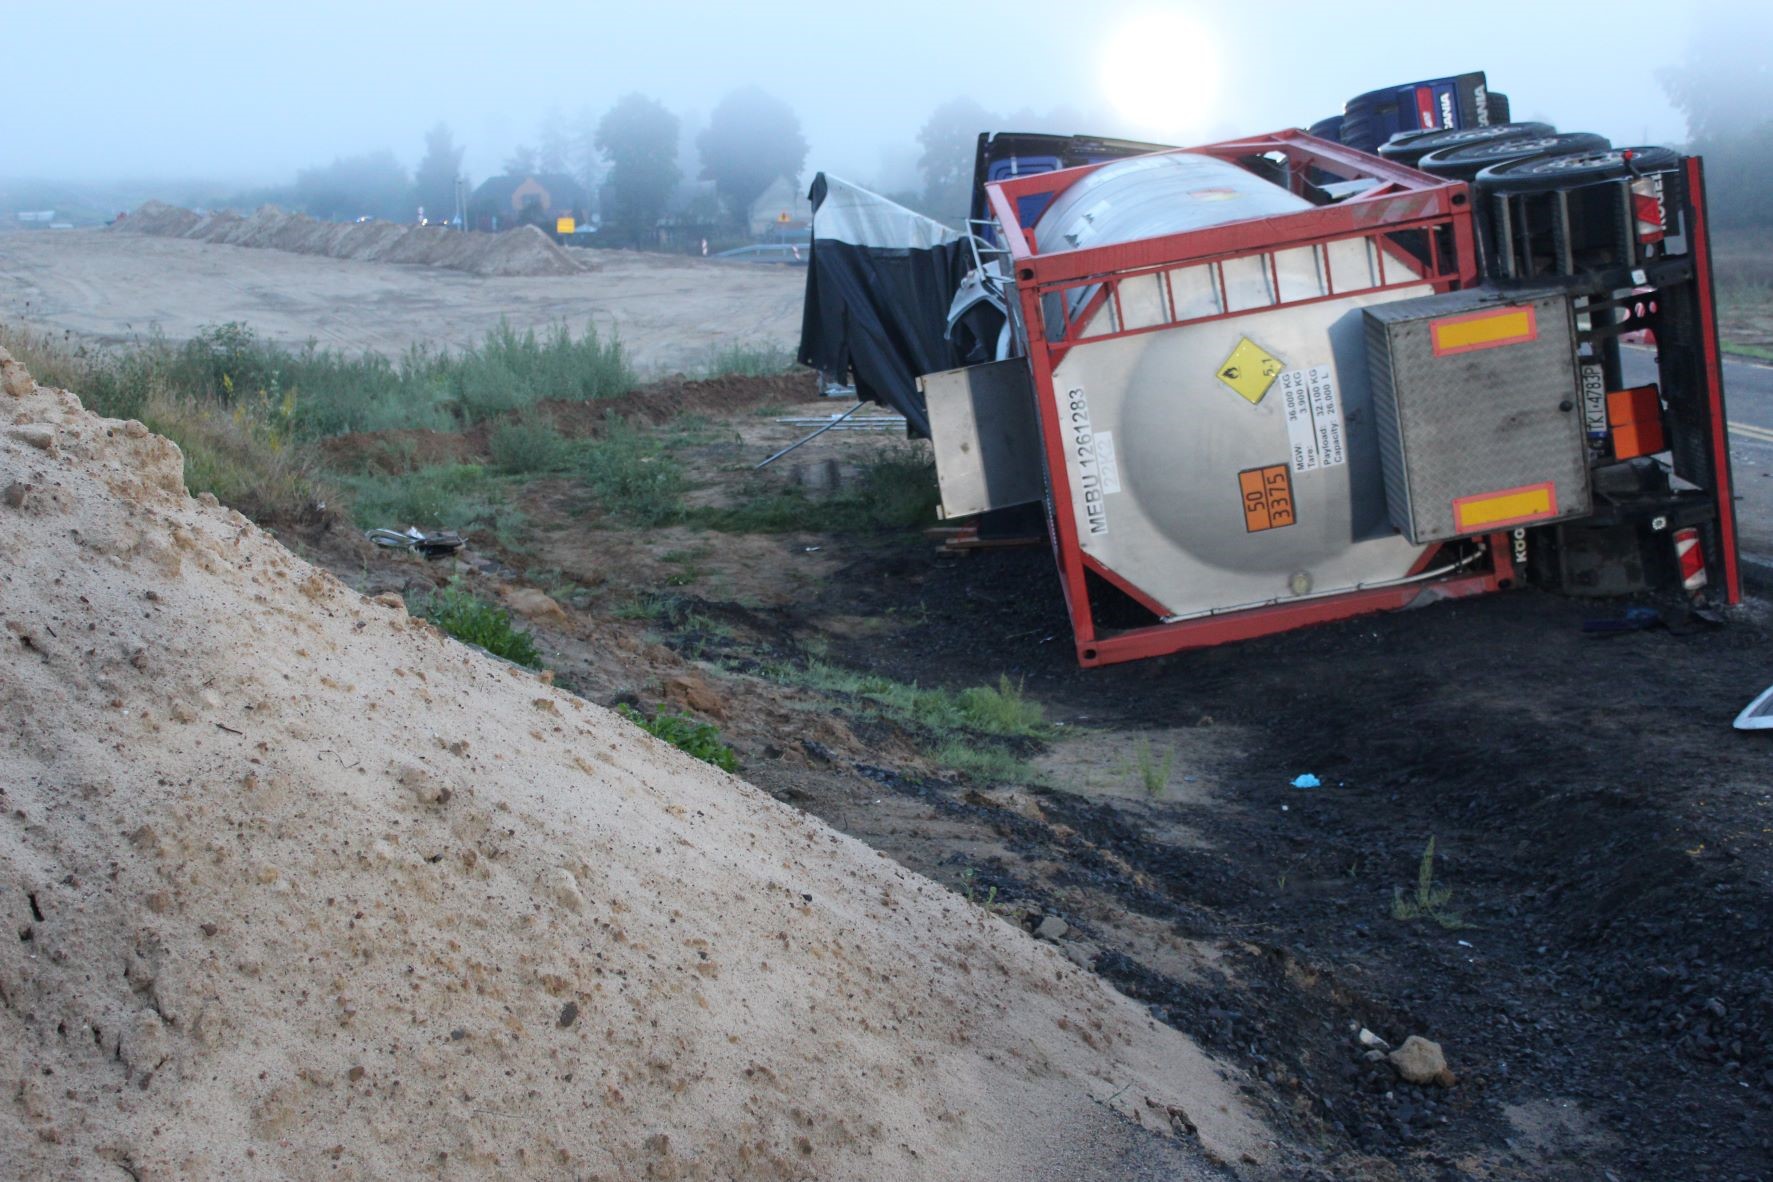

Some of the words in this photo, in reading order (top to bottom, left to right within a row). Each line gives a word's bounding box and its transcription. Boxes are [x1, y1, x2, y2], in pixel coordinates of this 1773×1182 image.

[1282, 374, 1292, 389] KG
[1293, 371, 1303, 387] KG
[1309, 369, 1319, 385] KG
[1323, 384, 1336, 415] 26.000
[1069, 388, 1093, 468] 1261283
[1097, 439, 1117, 488] 22K2
[1082, 474, 1107, 534] MEBU
[1246, 491, 1265, 512] 50
[1267, 473, 1290, 520] 3375
